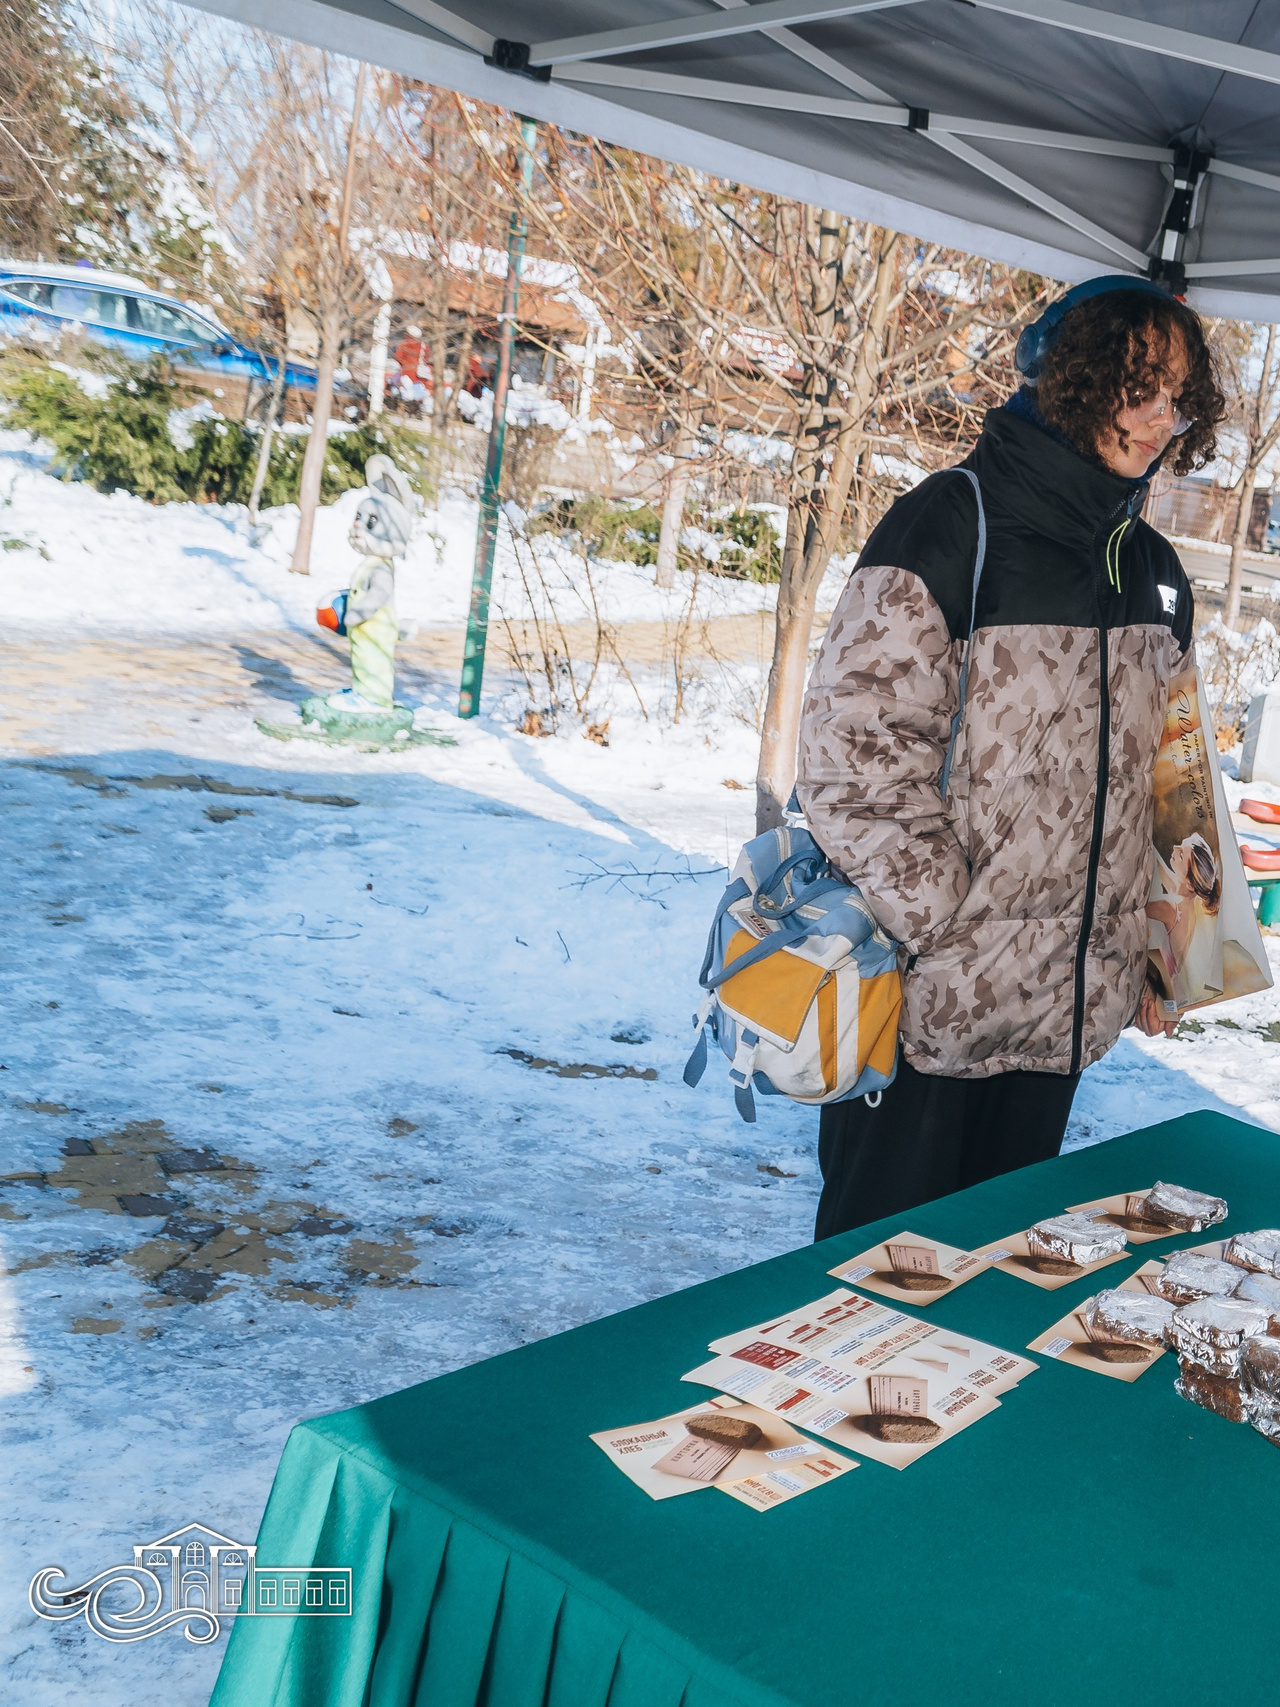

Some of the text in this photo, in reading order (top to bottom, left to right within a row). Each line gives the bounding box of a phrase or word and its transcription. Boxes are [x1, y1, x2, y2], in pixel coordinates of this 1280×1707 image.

[1176, 689, 1206, 819] Water-colors
[1193, 733, 1201, 757] PAPER
[1201, 776, 1212, 810] PAINTING
[610, 1429, 668, 1448] БЛОКАДНЫЙ
[616, 1444, 643, 1455] ХЛЕБ
